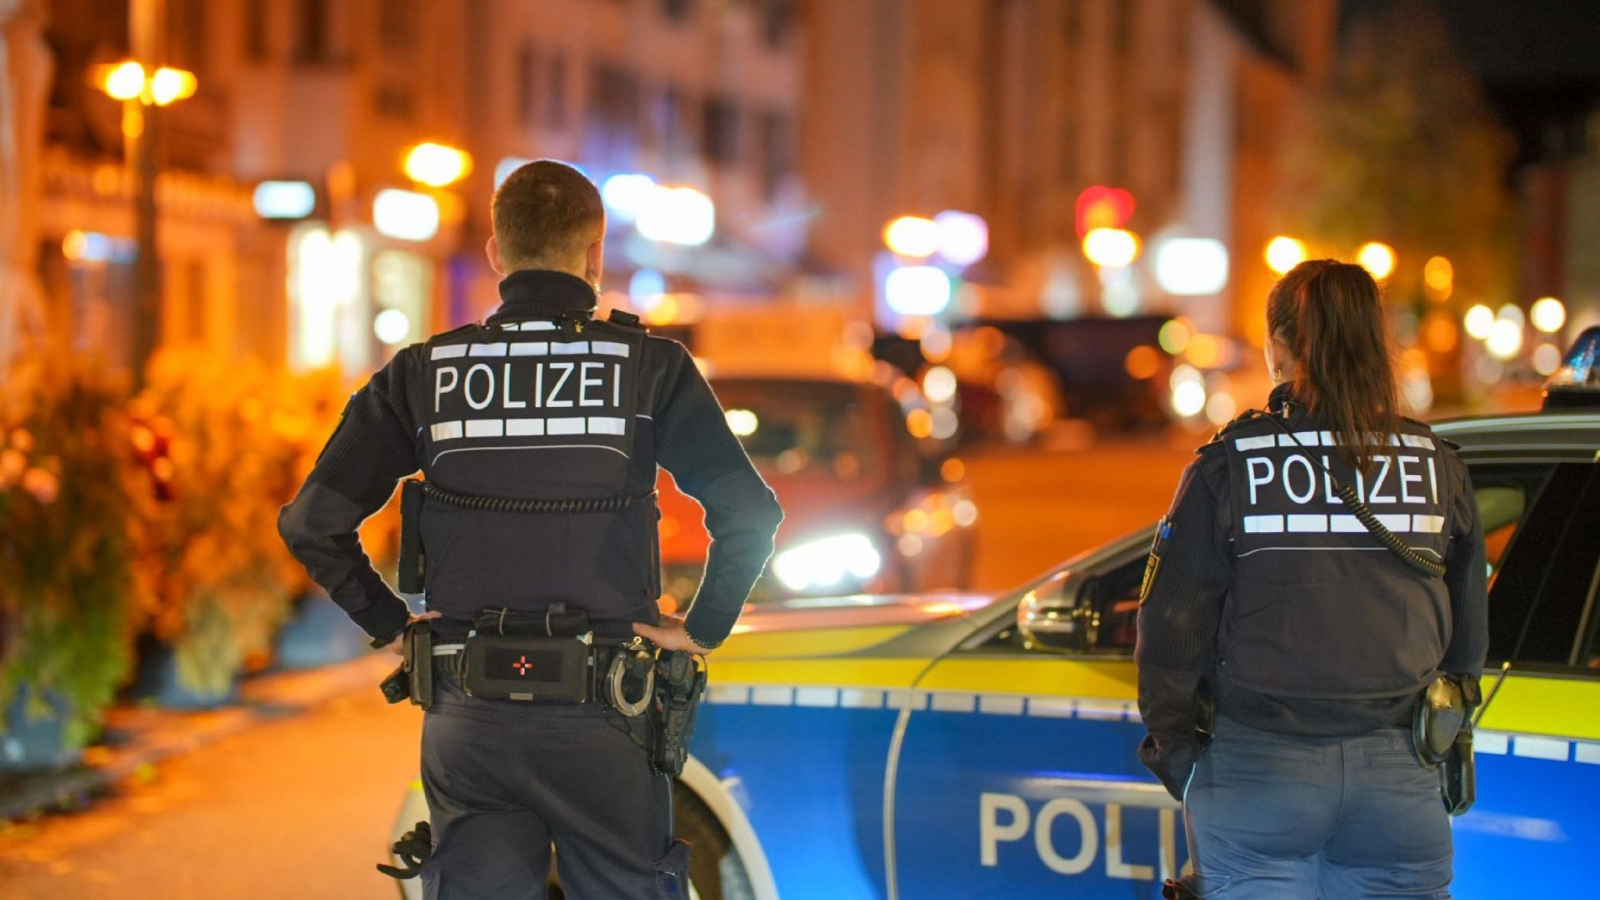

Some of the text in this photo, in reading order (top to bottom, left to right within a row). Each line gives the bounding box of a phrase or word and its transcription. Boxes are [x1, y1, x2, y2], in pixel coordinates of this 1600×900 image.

[435, 362, 620, 413] POLIZEI
[1247, 454, 1438, 505] POLIZEI
[980, 792, 1192, 882] POLI
